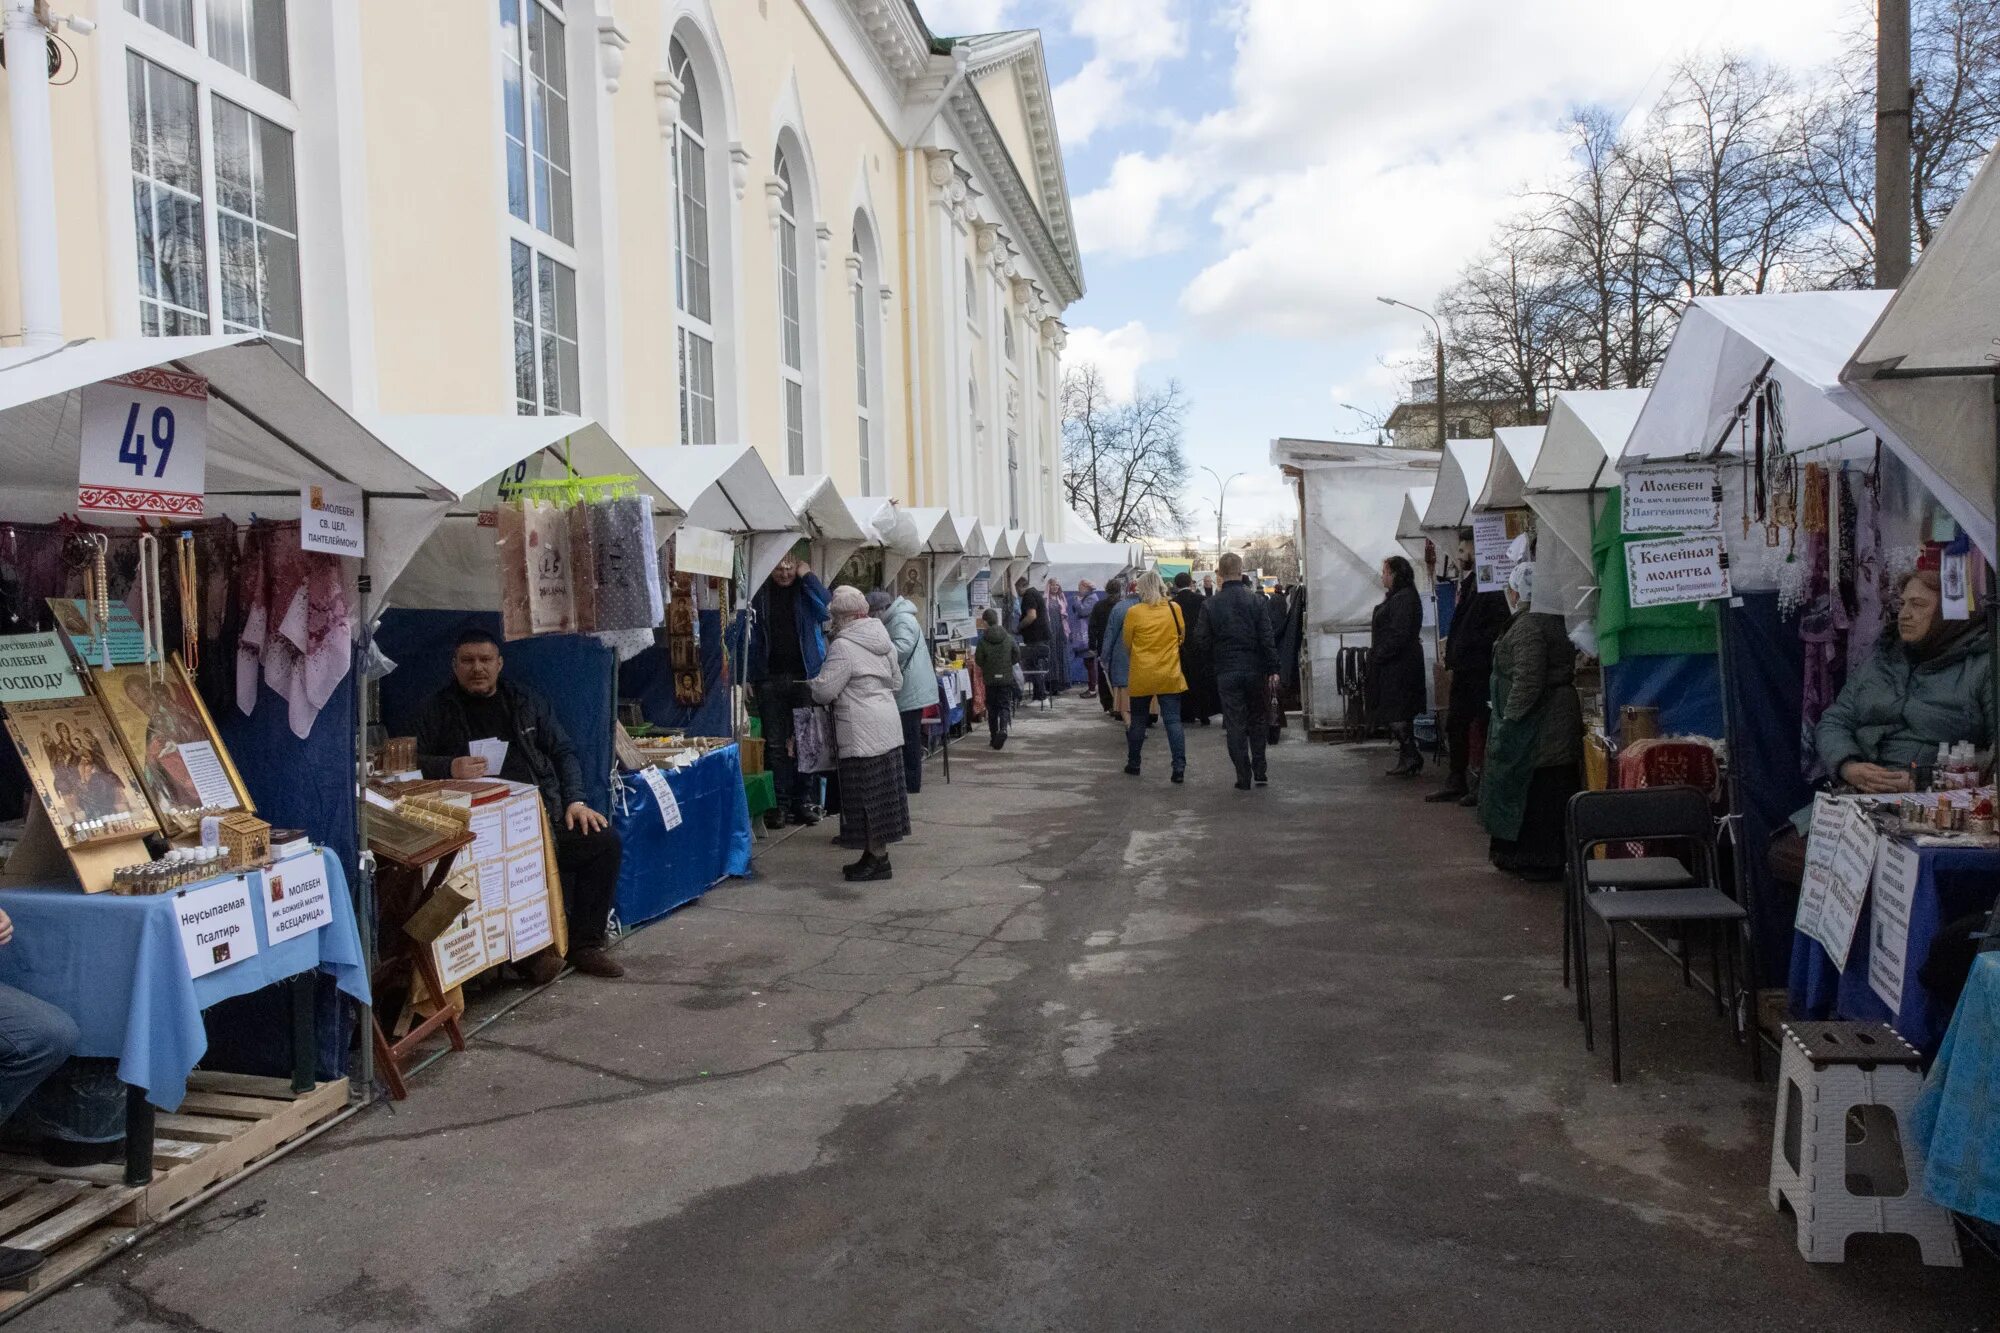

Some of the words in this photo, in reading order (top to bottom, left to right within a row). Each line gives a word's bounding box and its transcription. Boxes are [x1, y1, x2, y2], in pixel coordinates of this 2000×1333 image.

[119, 402, 175, 478] 49
[322, 503, 355, 517] МОЛЕБЕН
[320, 519, 331, 529] СВ.
[332, 520, 347, 532] ЦЕЛ.
[308, 533, 358, 549] ПАНТЕЛЕЙМОНУ
[0, 654, 48, 667] ОЛЕБЕН
[289, 878, 321, 896] МОЛЕБЕН
[181, 897, 246, 926] Неусыпаемая
[282, 900, 304, 914] БОЖИЕЙ
[305, 893, 324, 906] МАТЕРИ
[276, 908, 324, 932] «ВСЕЦАРИЦА»
[196, 923, 240, 946] Псалтирь
